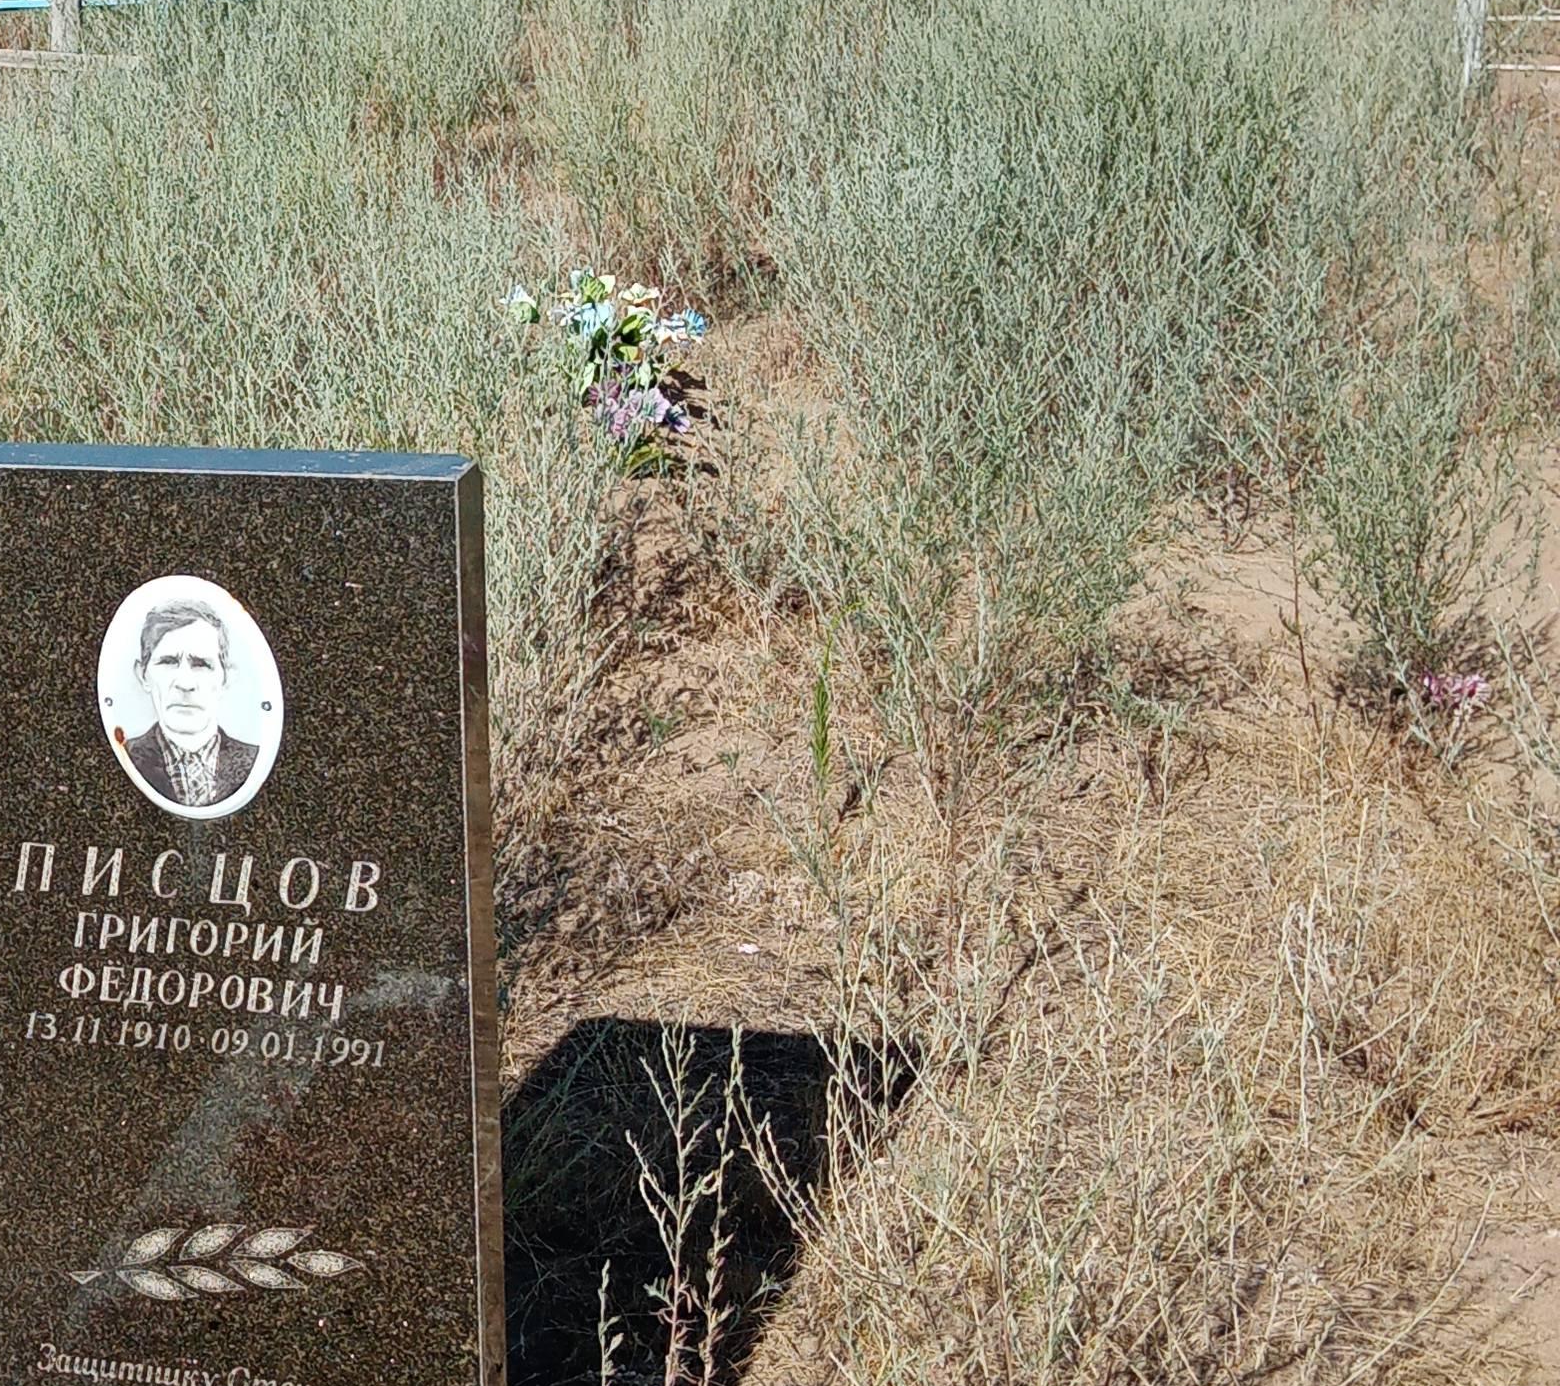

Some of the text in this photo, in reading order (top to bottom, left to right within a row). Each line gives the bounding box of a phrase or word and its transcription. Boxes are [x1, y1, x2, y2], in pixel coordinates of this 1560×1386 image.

[12, 841, 382, 916] ПИСЦОВ
[74, 911, 324, 964] ГРИГОРИЙ
[58, 960, 344, 1021] ФЁДОРОВИЧ
